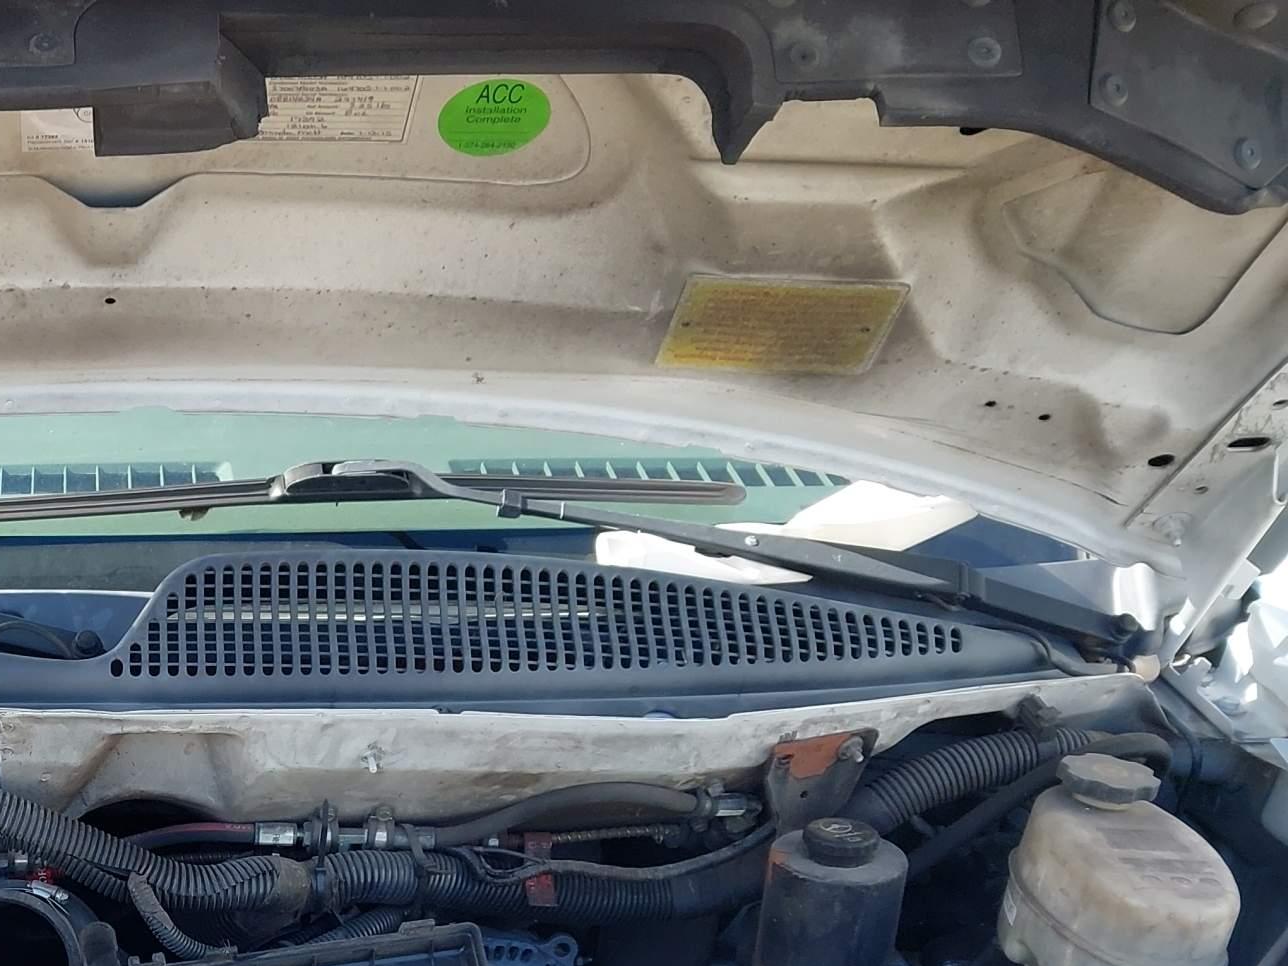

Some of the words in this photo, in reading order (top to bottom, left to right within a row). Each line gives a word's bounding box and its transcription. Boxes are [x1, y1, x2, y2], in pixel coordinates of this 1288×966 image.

[476, 83, 525, 104] ACC
[465, 106, 527, 115] Installation
[465, 115, 521, 125] Complete
